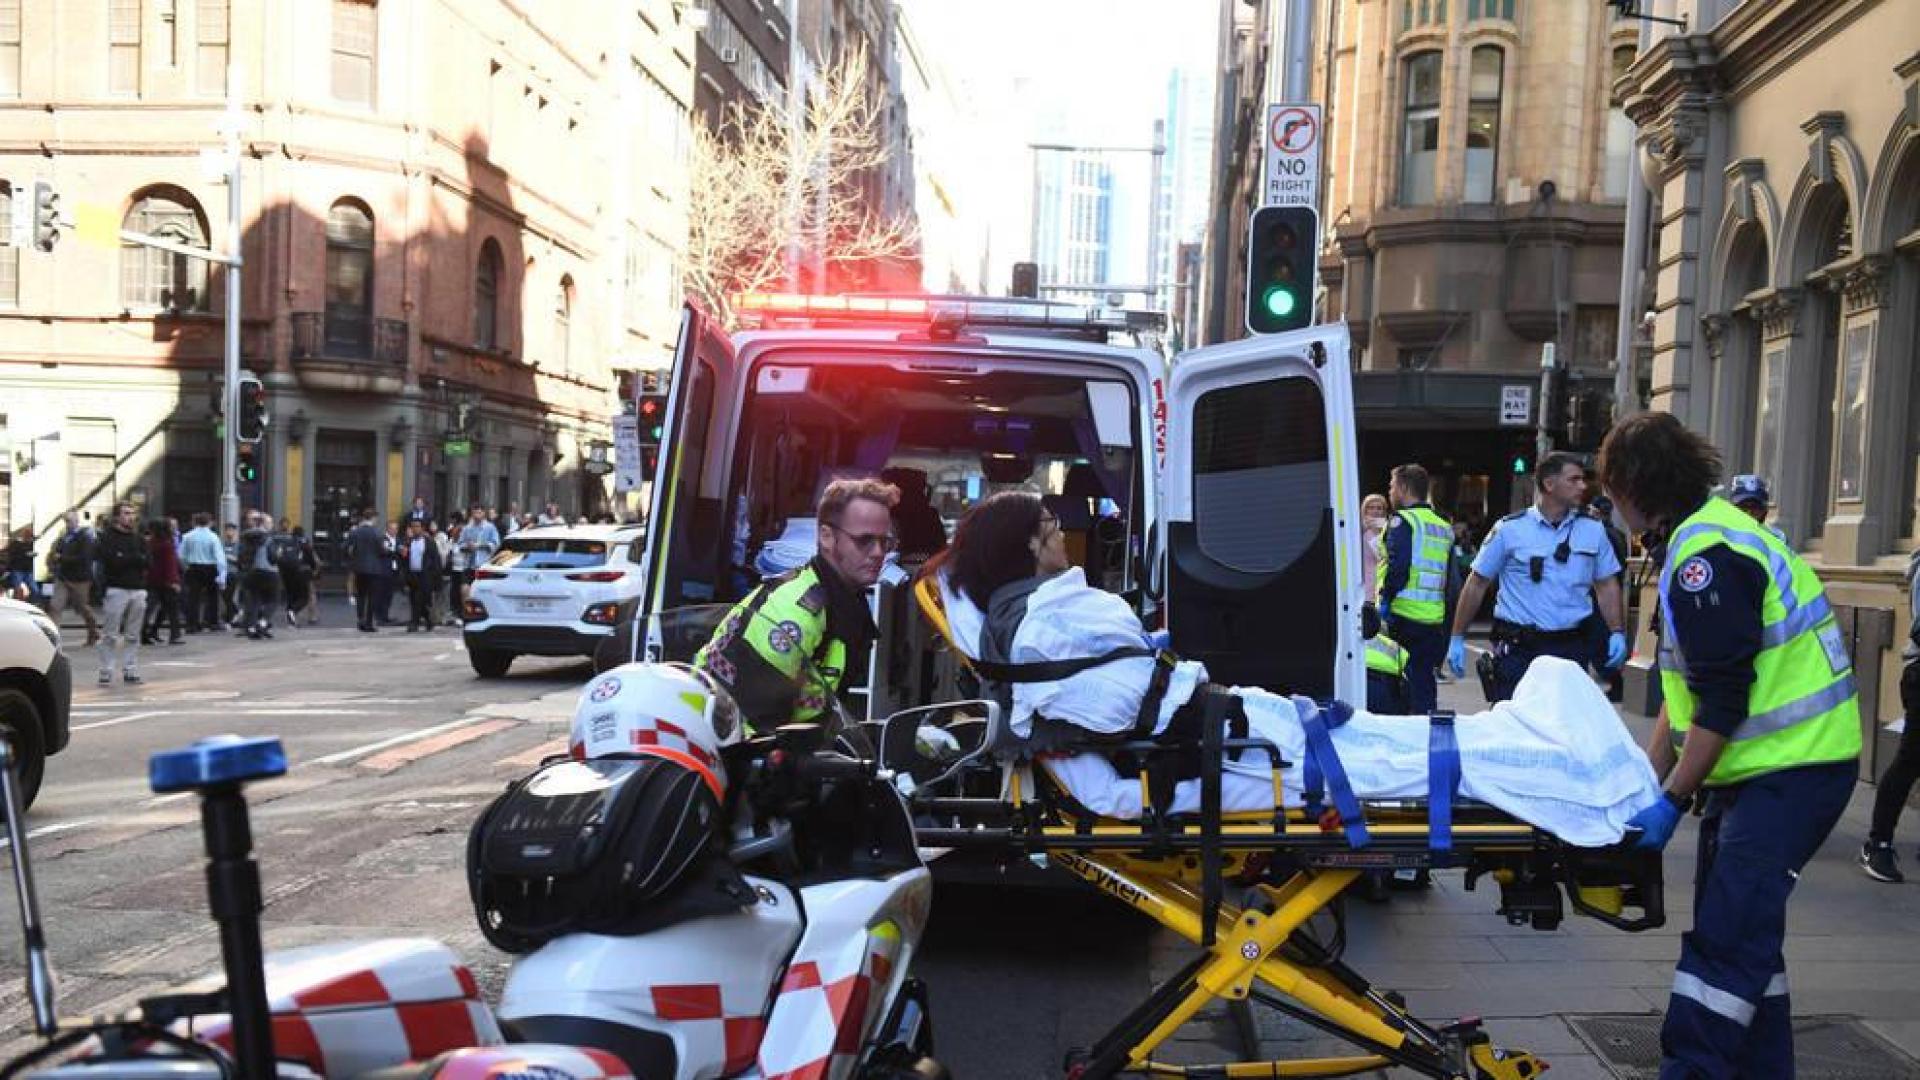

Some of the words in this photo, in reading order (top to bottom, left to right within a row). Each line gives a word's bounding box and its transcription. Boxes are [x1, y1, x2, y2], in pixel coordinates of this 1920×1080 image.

[1278, 159, 1306, 176] NO
[1271, 180, 1311, 191] RIGHT
[1272, 195, 1310, 205] TURN
[1505, 389, 1526, 399] ONE
[1504, 400, 1526, 410] WAY
